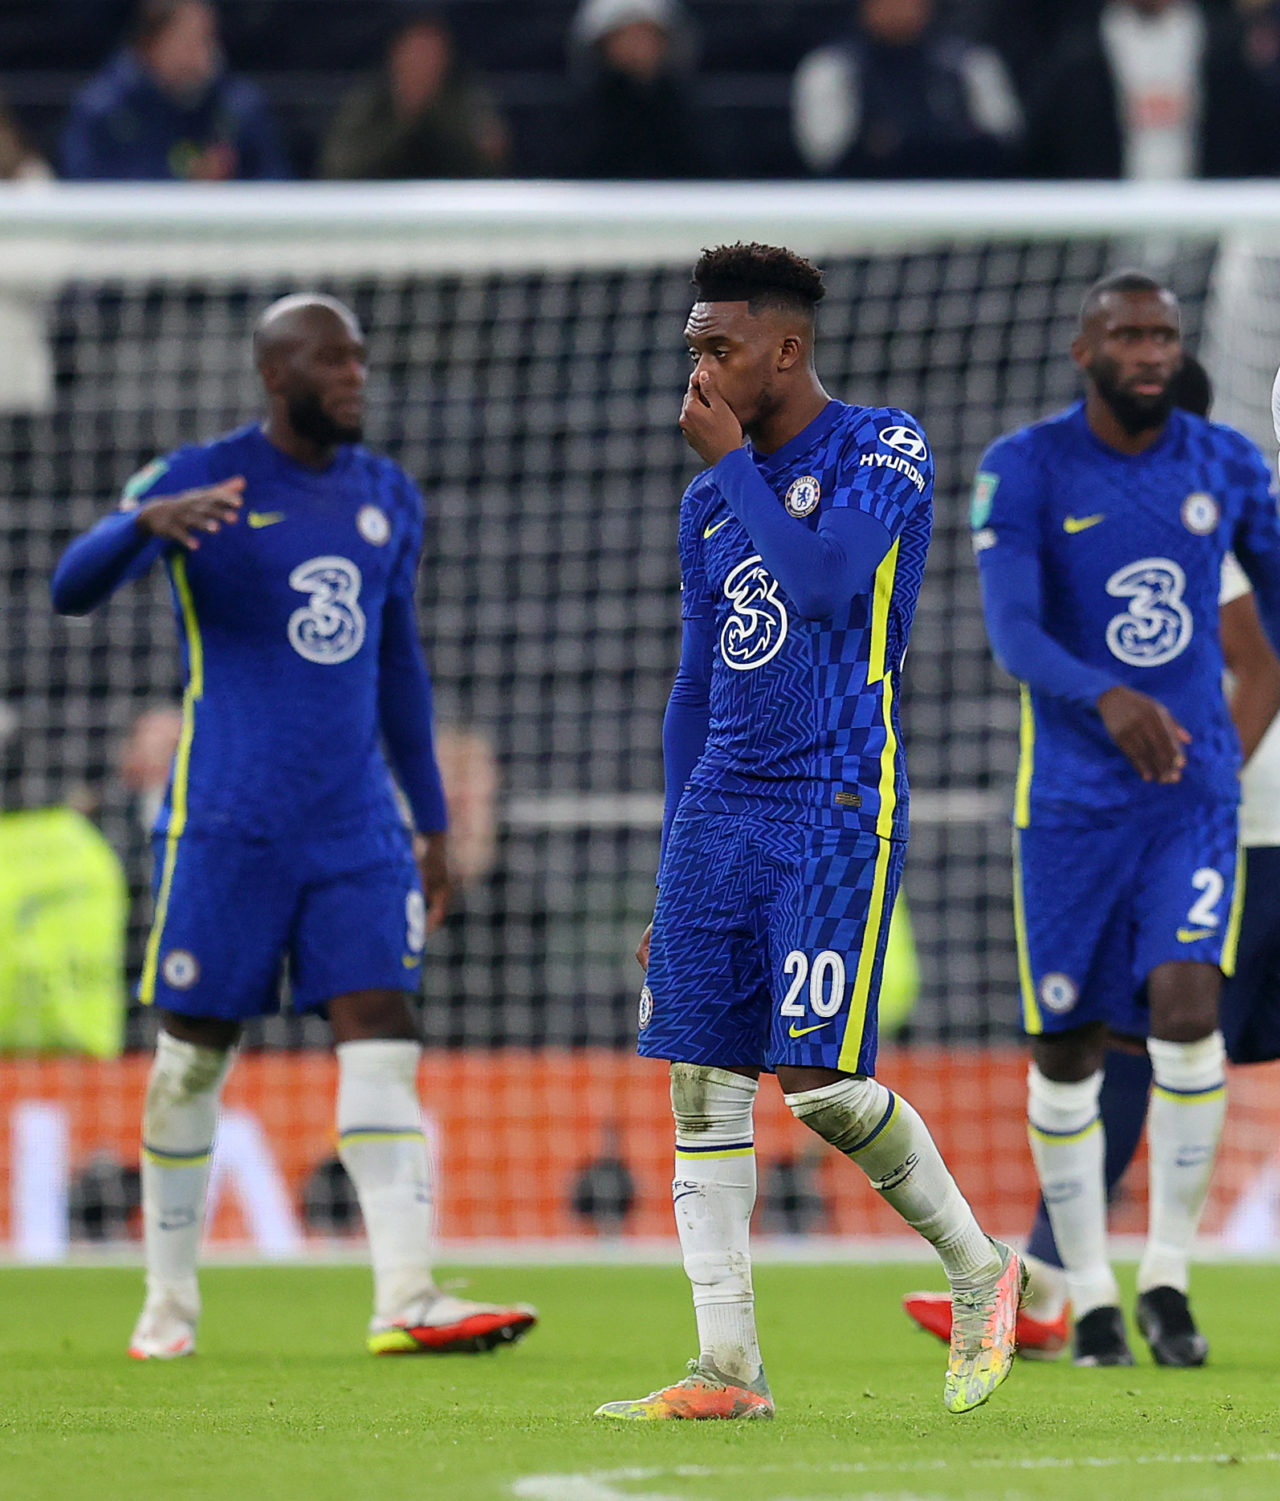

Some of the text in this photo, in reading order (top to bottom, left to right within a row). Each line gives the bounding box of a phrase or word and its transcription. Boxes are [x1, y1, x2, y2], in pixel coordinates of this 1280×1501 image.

[860, 452, 926, 494] HYUNDAI
[1188, 867, 1225, 928] 2
[780, 949, 846, 1018] 20
[672, 1180, 699, 1190] FC
